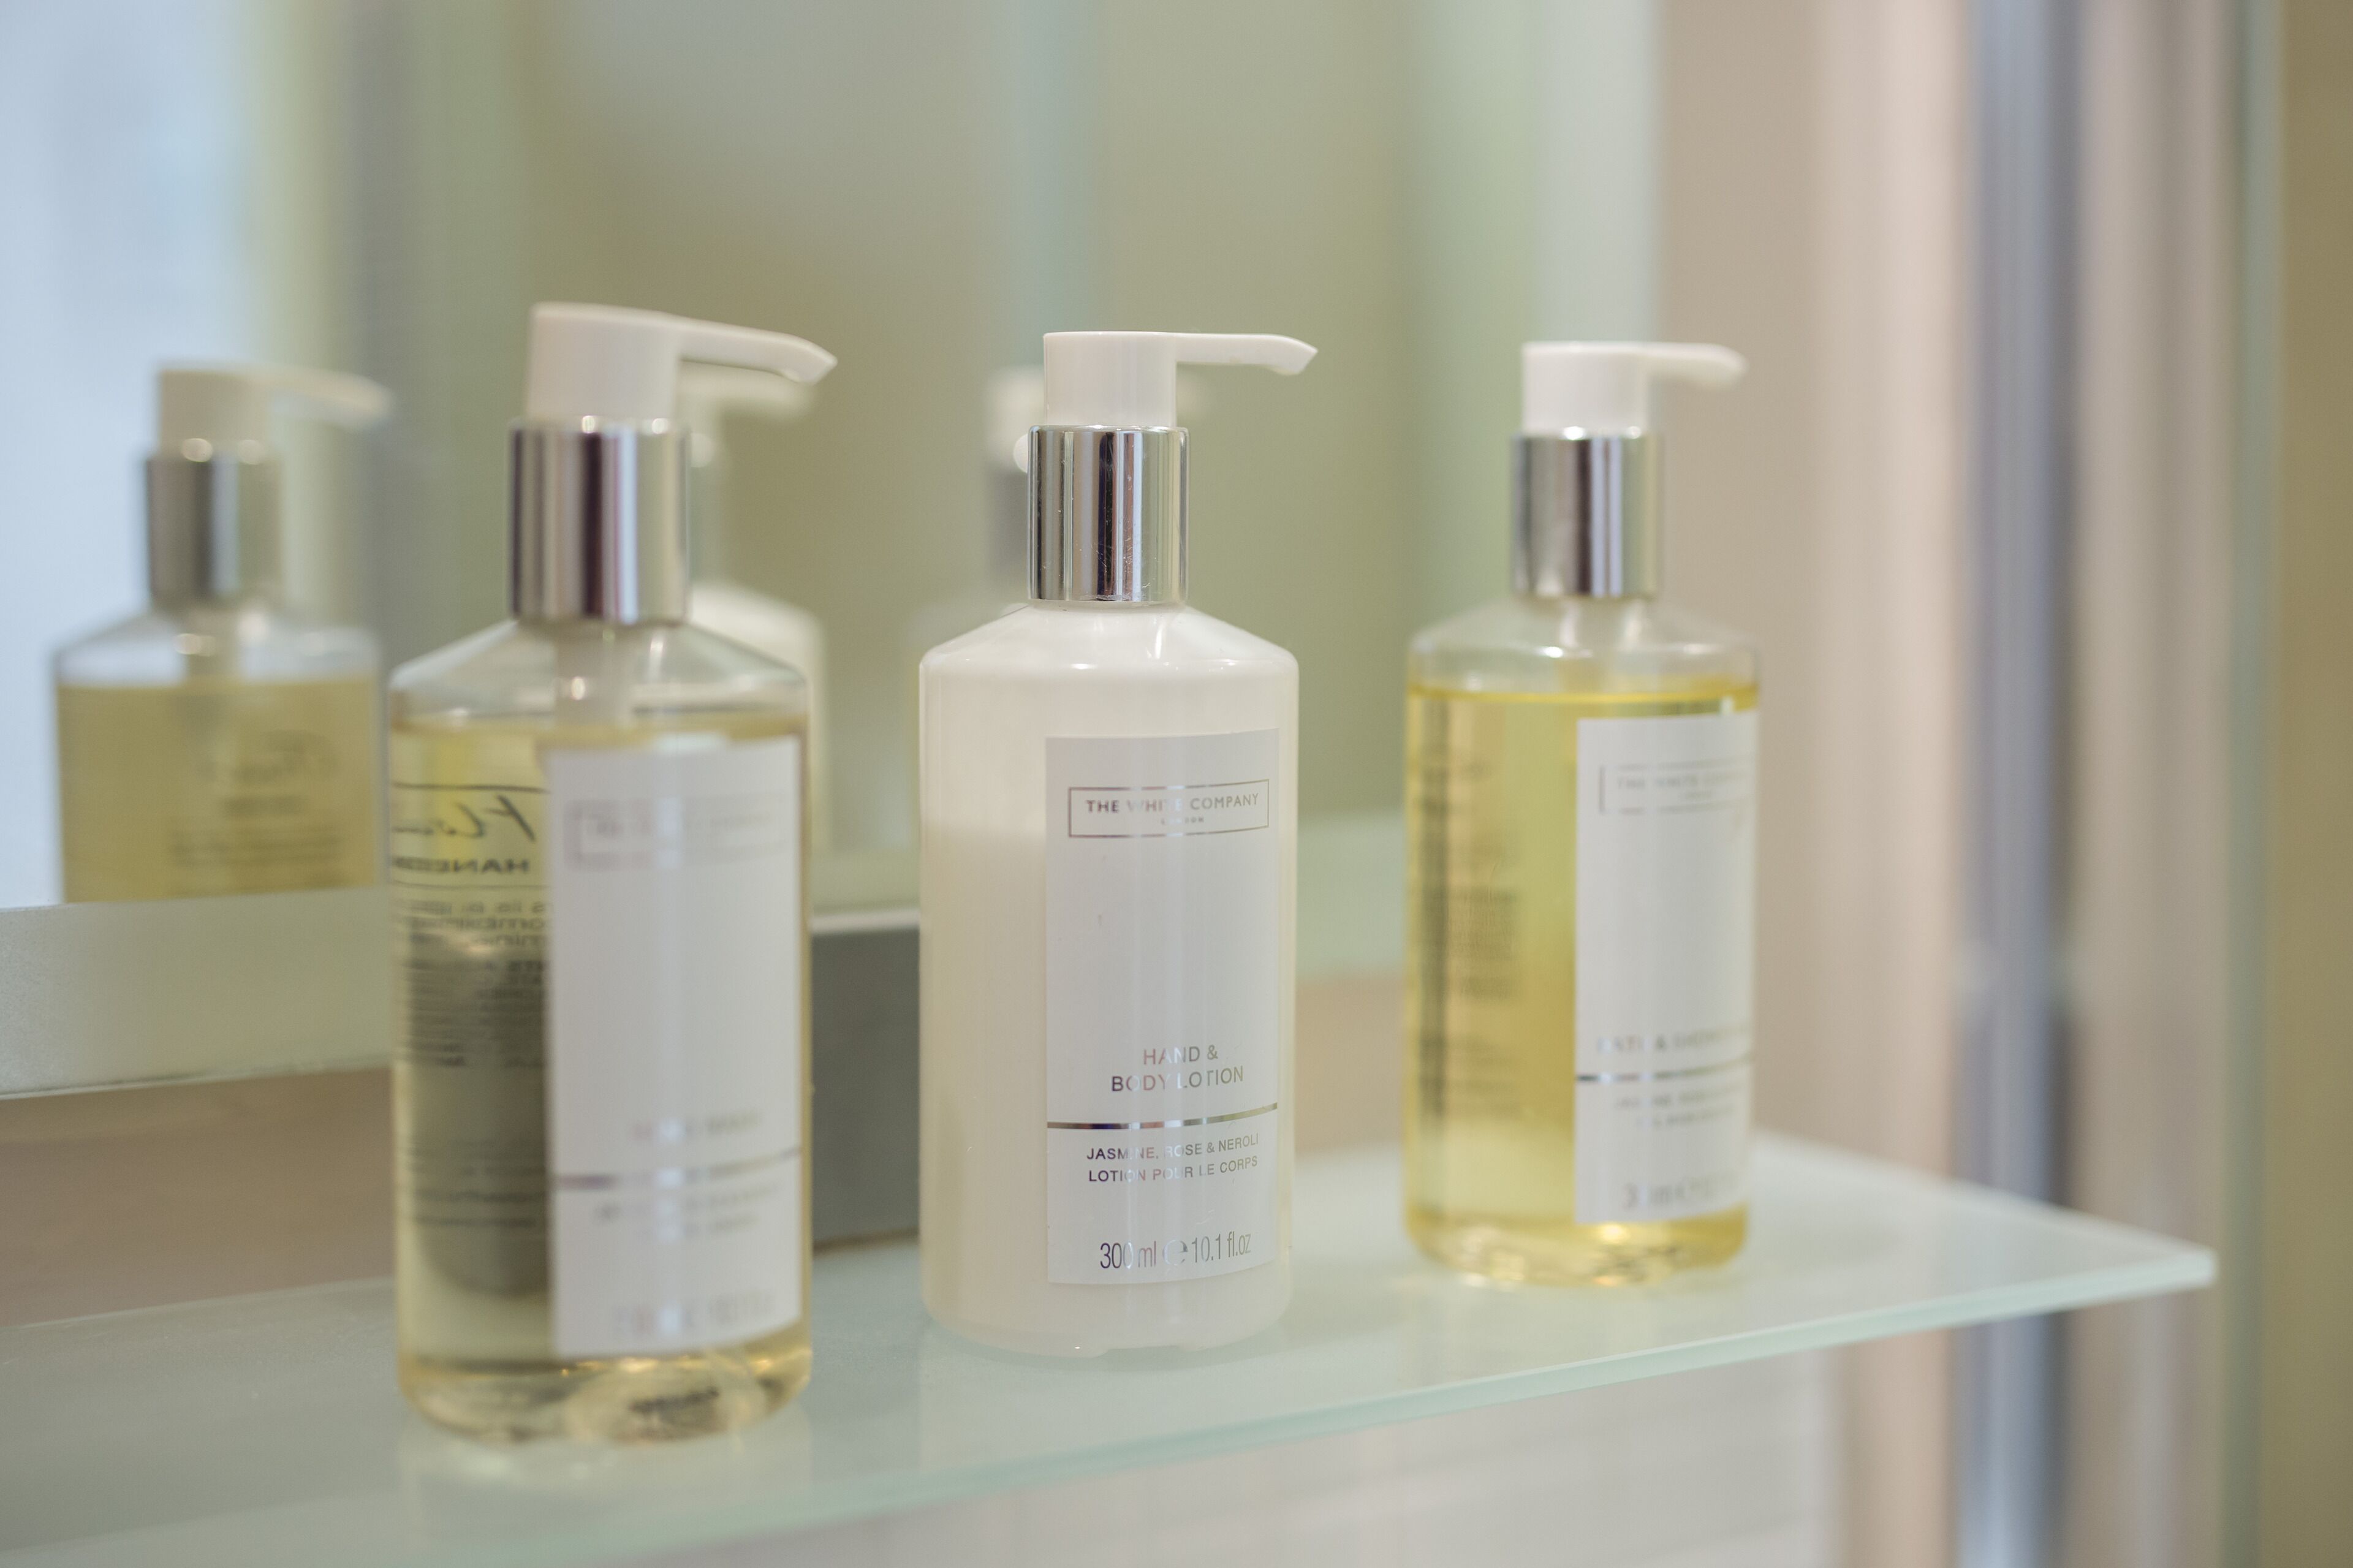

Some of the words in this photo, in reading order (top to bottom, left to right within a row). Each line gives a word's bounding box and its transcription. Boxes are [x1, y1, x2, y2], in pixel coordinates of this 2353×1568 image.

[1086, 799, 1120, 813] THE
[1190, 793, 1259, 810] COMPANY
[1143, 1046, 1200, 1064] HAND
[1207, 1044, 1218, 1060] &
[1112, 1074, 1171, 1091] BODY
[1176, 1066, 1243, 1089] LOTION
[1164, 1143, 1202, 1157] ROSE
[1207, 1142, 1215, 1153] &
[1219, 1133, 1259, 1152] NEROLI
[1089, 1168, 1146, 1182] LOTION
[1153, 1167, 1193, 1180] POUR
[1199, 1164, 1214, 1176] LE
[1220, 1156, 1257, 1173] CORPS
[1191, 1233, 1221, 1263] 10.1
